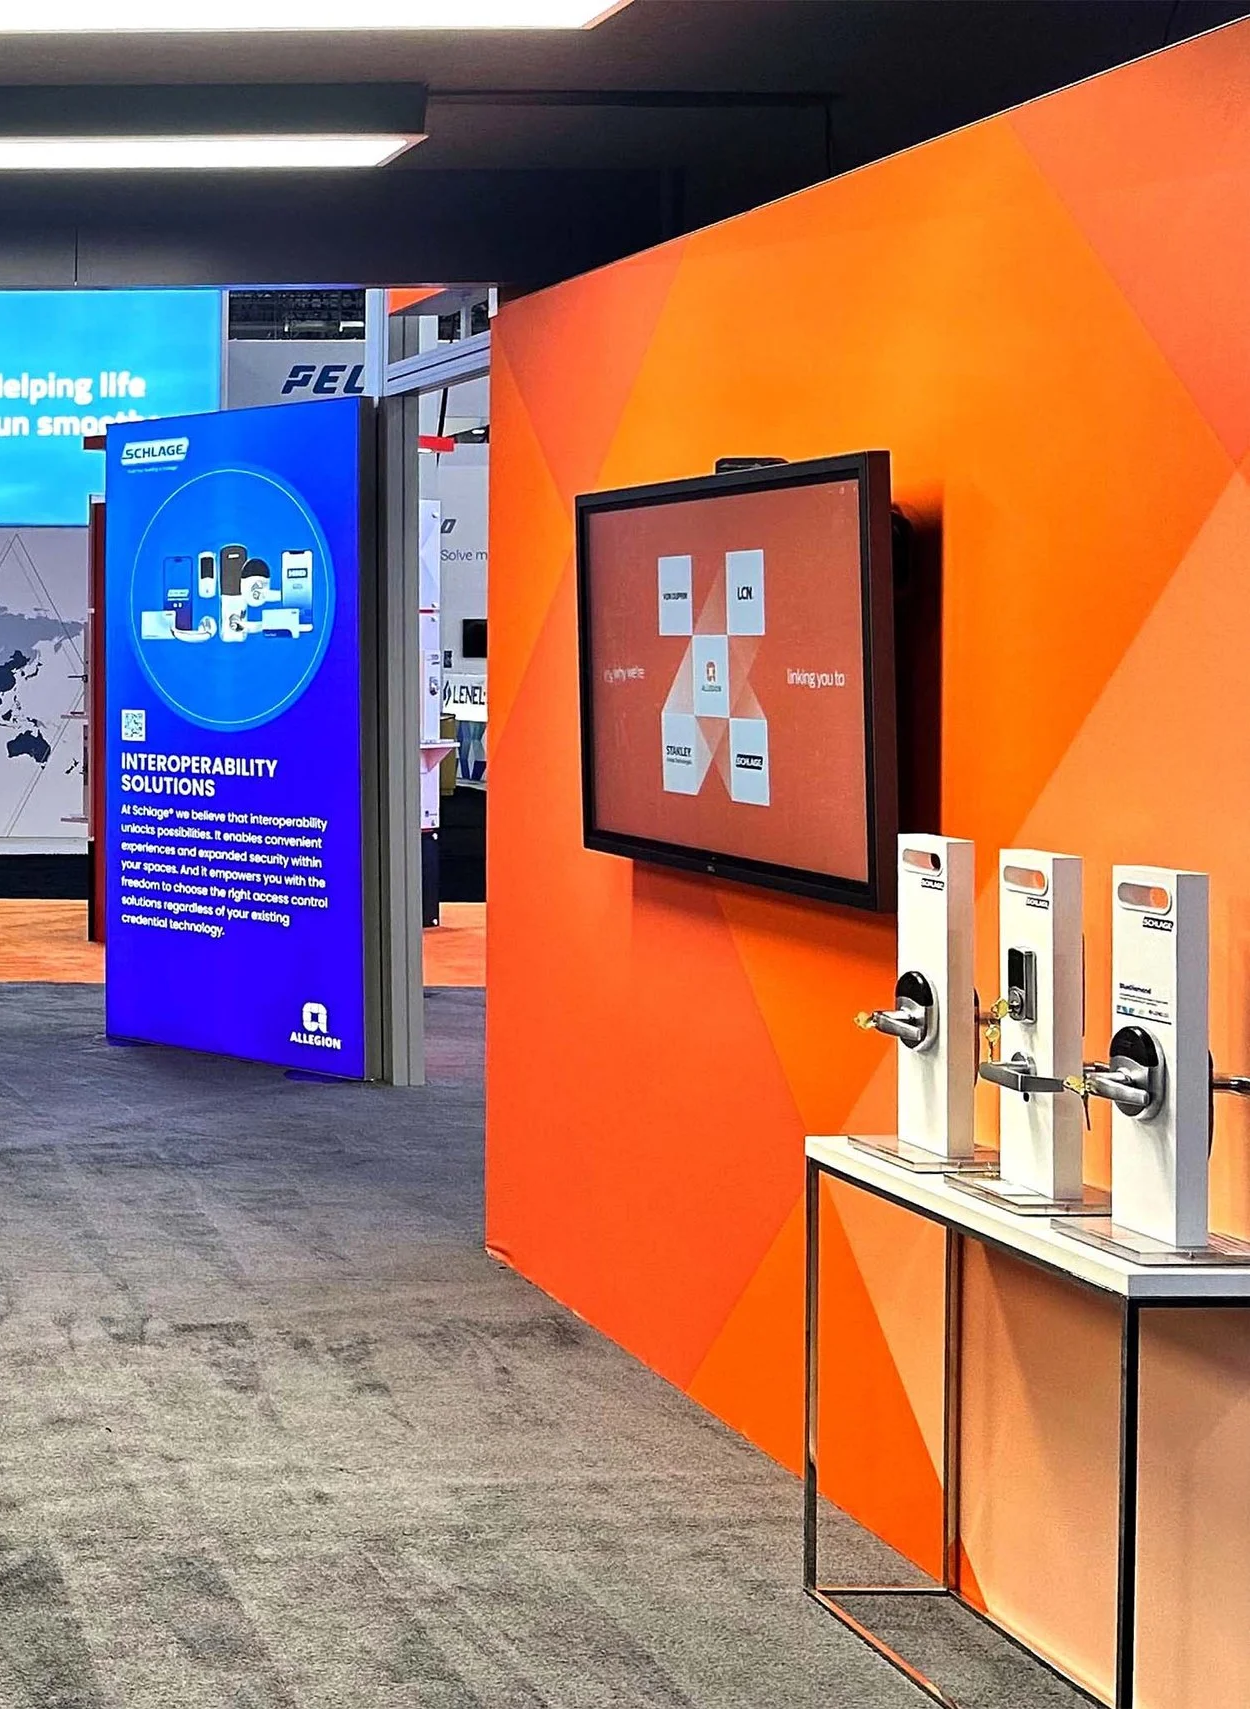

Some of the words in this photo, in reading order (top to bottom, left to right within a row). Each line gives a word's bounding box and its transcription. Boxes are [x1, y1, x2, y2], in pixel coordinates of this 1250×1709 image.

[100, 371, 146, 398] life
[122, 443, 185, 459] SCHLAGE
[440, 549, 472, 561] Solve
[737, 586, 753, 600] LCN
[787, 668, 816, 688] linking
[817, 672, 833, 688] you
[834, 670, 845, 686] to
[121, 752, 278, 778] INTEROPERABILITY
[121, 774, 216, 797] SOLUTIONS
[121, 804, 131, 815] At
[176, 810, 190, 819] we
[191, 809, 226, 821] believe
[227, 812, 248, 824] that
[250, 813, 328, 832] interoperability
[121, 823, 156, 836] unlocks
[157, 826, 213, 840] possibilities.
[214, 831, 222, 841] It
[222, 832, 263, 844] enables
[264, 836, 322, 849] convenient
[121, 842, 175, 855] experiences
[177, 847, 197, 857] and
[198, 850, 247, 862] expanded
[249, 853, 289, 869] security
[291, 855, 322, 869] within
[121, 860, 142, 871] your
[143, 862, 179, 874] spaces.
[180, 864, 199, 876] And
[201, 865, 208, 877] it
[209, 868, 261, 883] empowers
[263, 874, 282, 886] you
[284, 874, 306, 887] with
[307, 876, 326, 888] the
[121, 875, 160, 891] freedom
[161, 881, 172, 892] to
[173, 883, 208, 896] choose
[209, 886, 226, 898] the
[228, 887, 251, 903] right
[253, 892, 289, 905] access
[291, 896, 328, 908] control
[121, 895, 162, 909] solutions
[163, 901, 213, 915] regardless
[215, 905, 225, 916] of
[227, 908, 249, 921] your
[251, 910, 290, 927] existing
[121, 913, 167, 928] credential
[169, 918, 225, 938] technology.
[290, 1031, 342, 1050] ALLEGION
